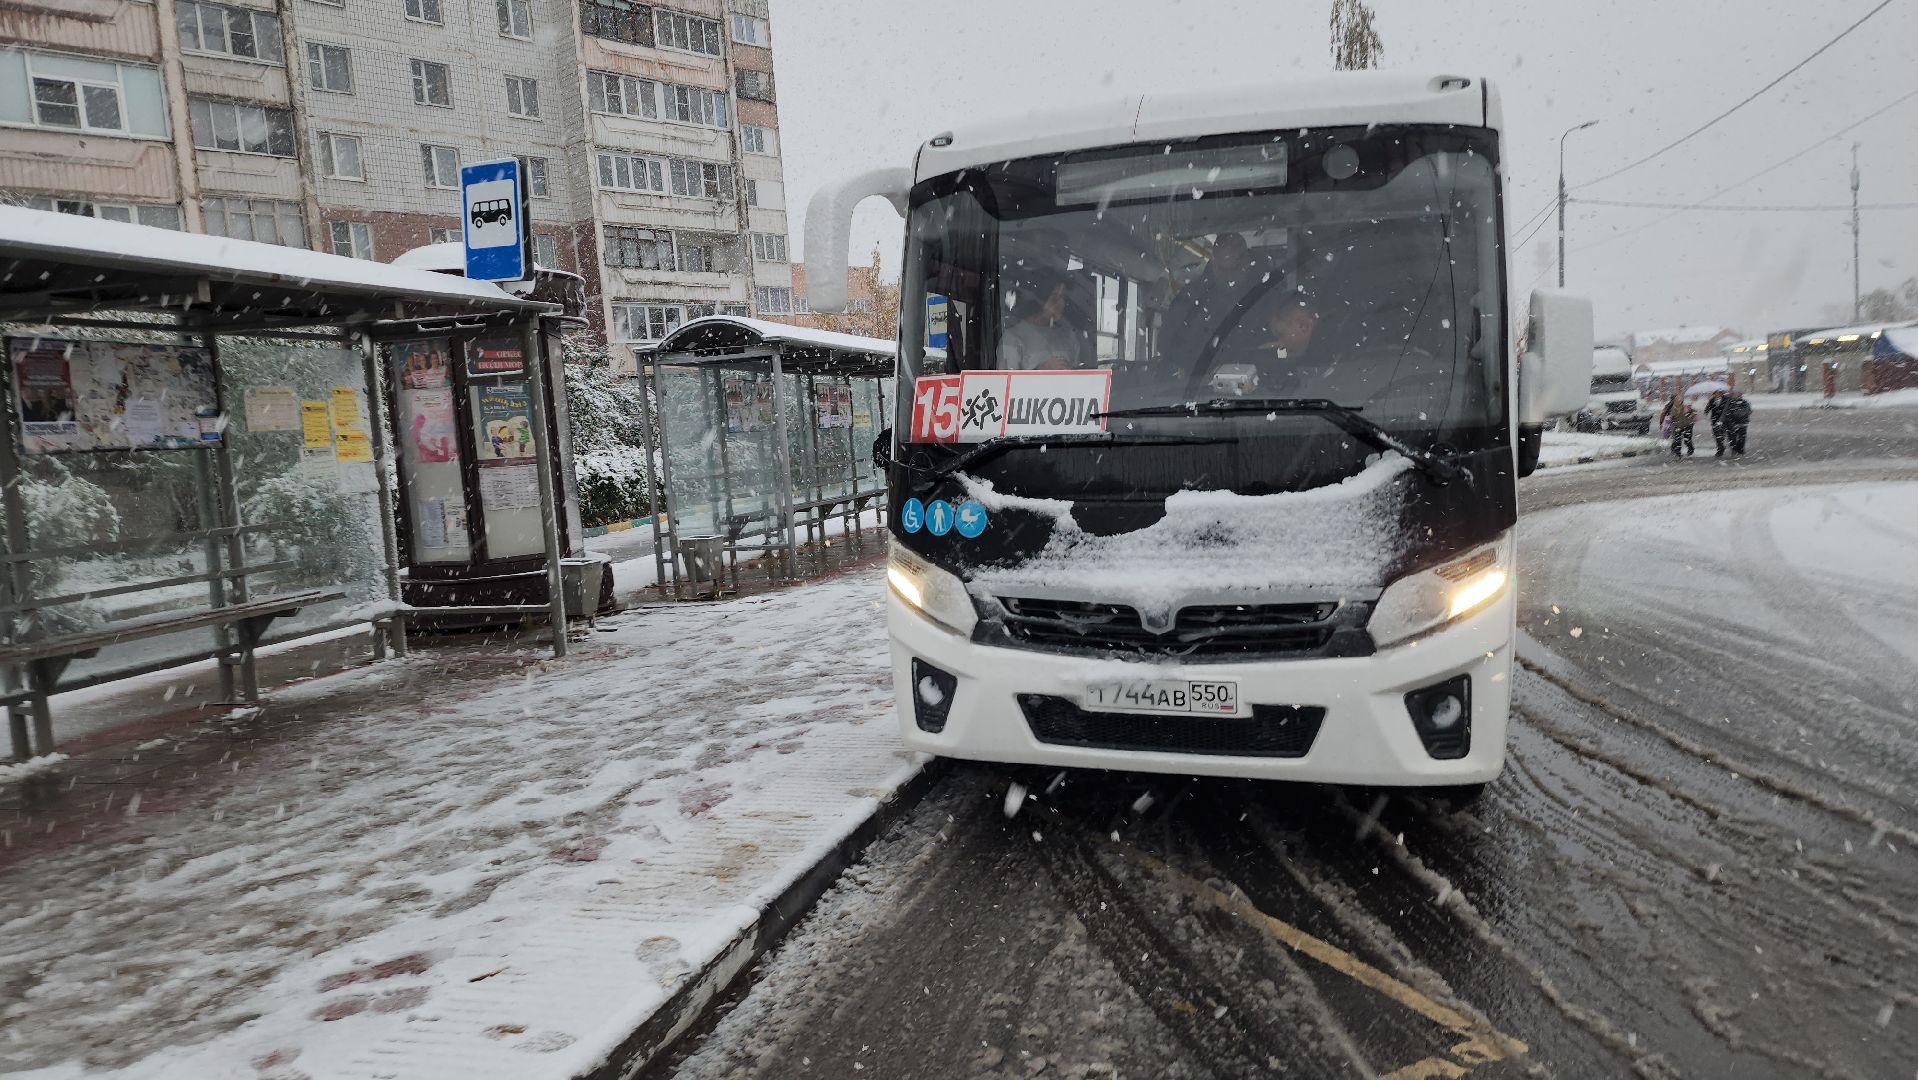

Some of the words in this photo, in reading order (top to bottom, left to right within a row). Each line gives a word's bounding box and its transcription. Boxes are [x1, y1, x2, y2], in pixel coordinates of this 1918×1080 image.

[916, 384, 960, 439] 15
[1007, 397, 1100, 426] ШКОЛА
[1191, 684, 1229, 702] 550
[1201, 702, 1220, 711] RUS
